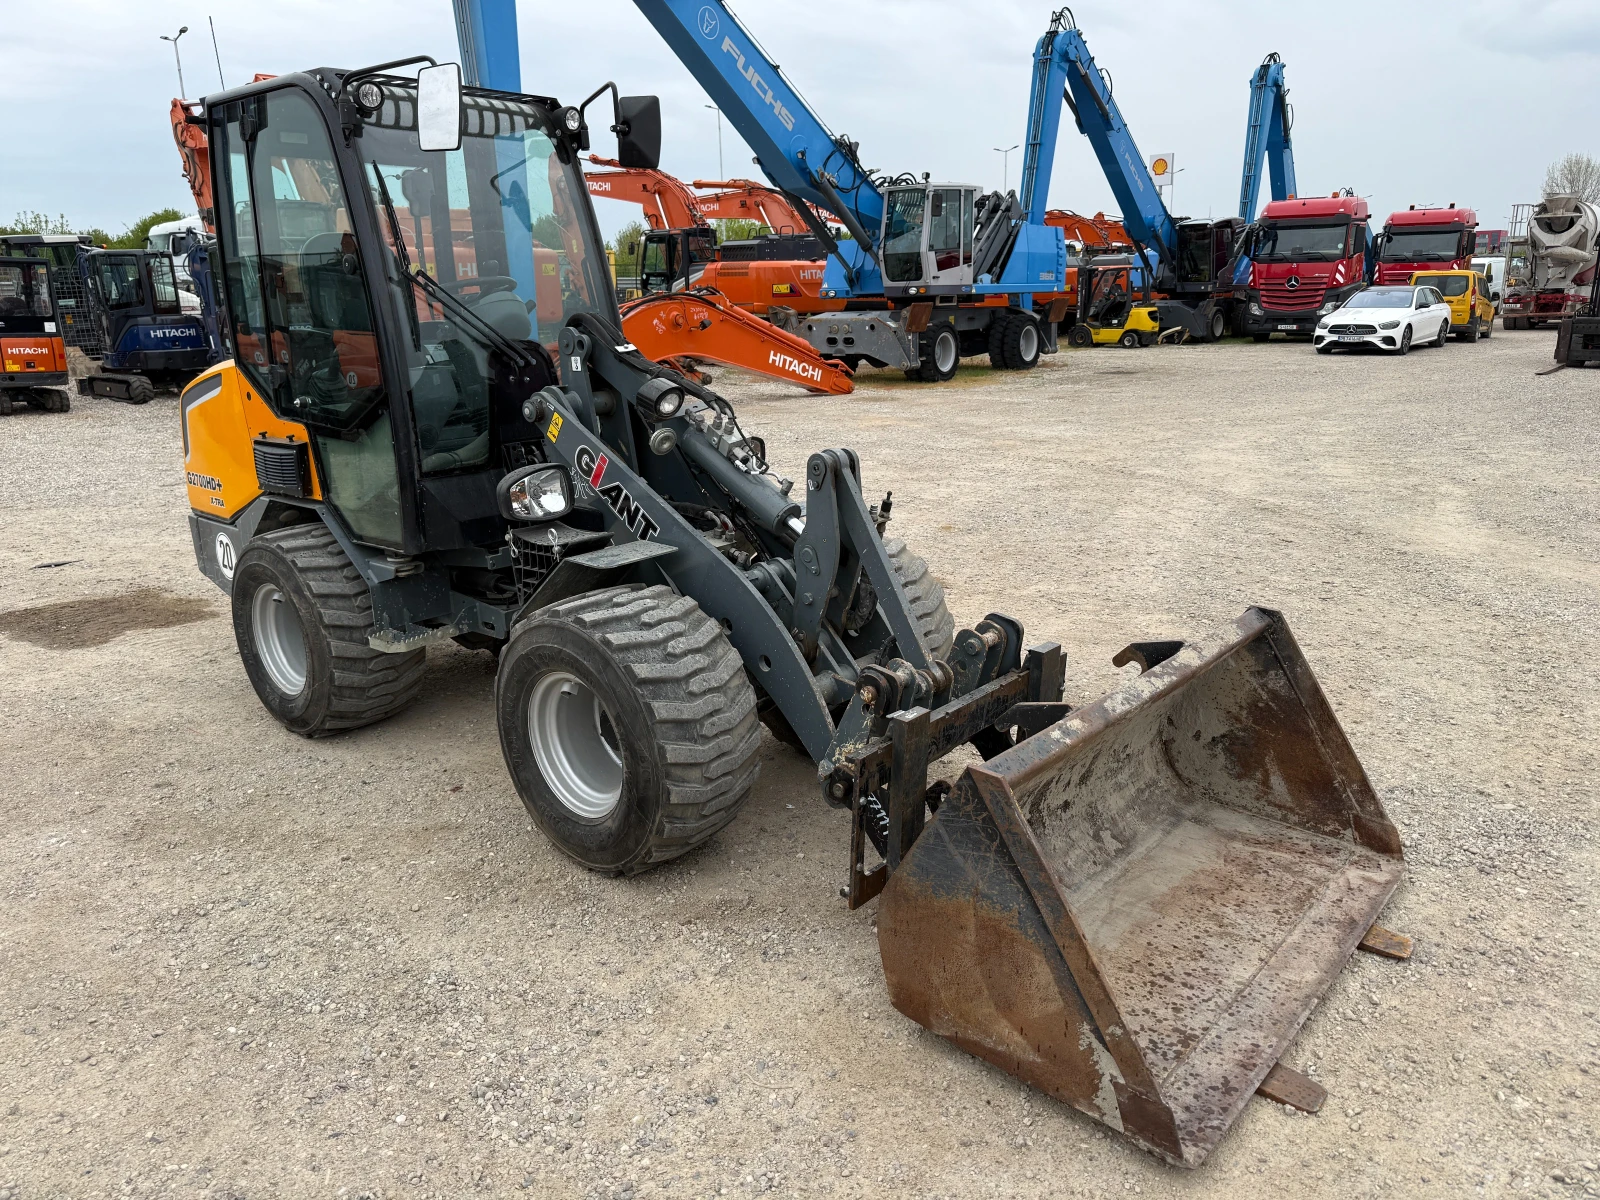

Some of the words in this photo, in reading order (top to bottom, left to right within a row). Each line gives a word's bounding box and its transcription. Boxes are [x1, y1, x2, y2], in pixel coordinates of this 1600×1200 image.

[721, 35, 796, 132] FUCHS
[700, 203, 719, 212] ACHI
[150, 328, 196, 338] HITACHI
[8, 347, 48, 355] HITACHI
[769, 350, 822, 383] HITACHI
[187, 471, 223, 493] G2700HD+
[575, 444, 660, 541] GIANT
[210, 496, 225, 508] X-TRA
[218, 539, 234, 572] 20
